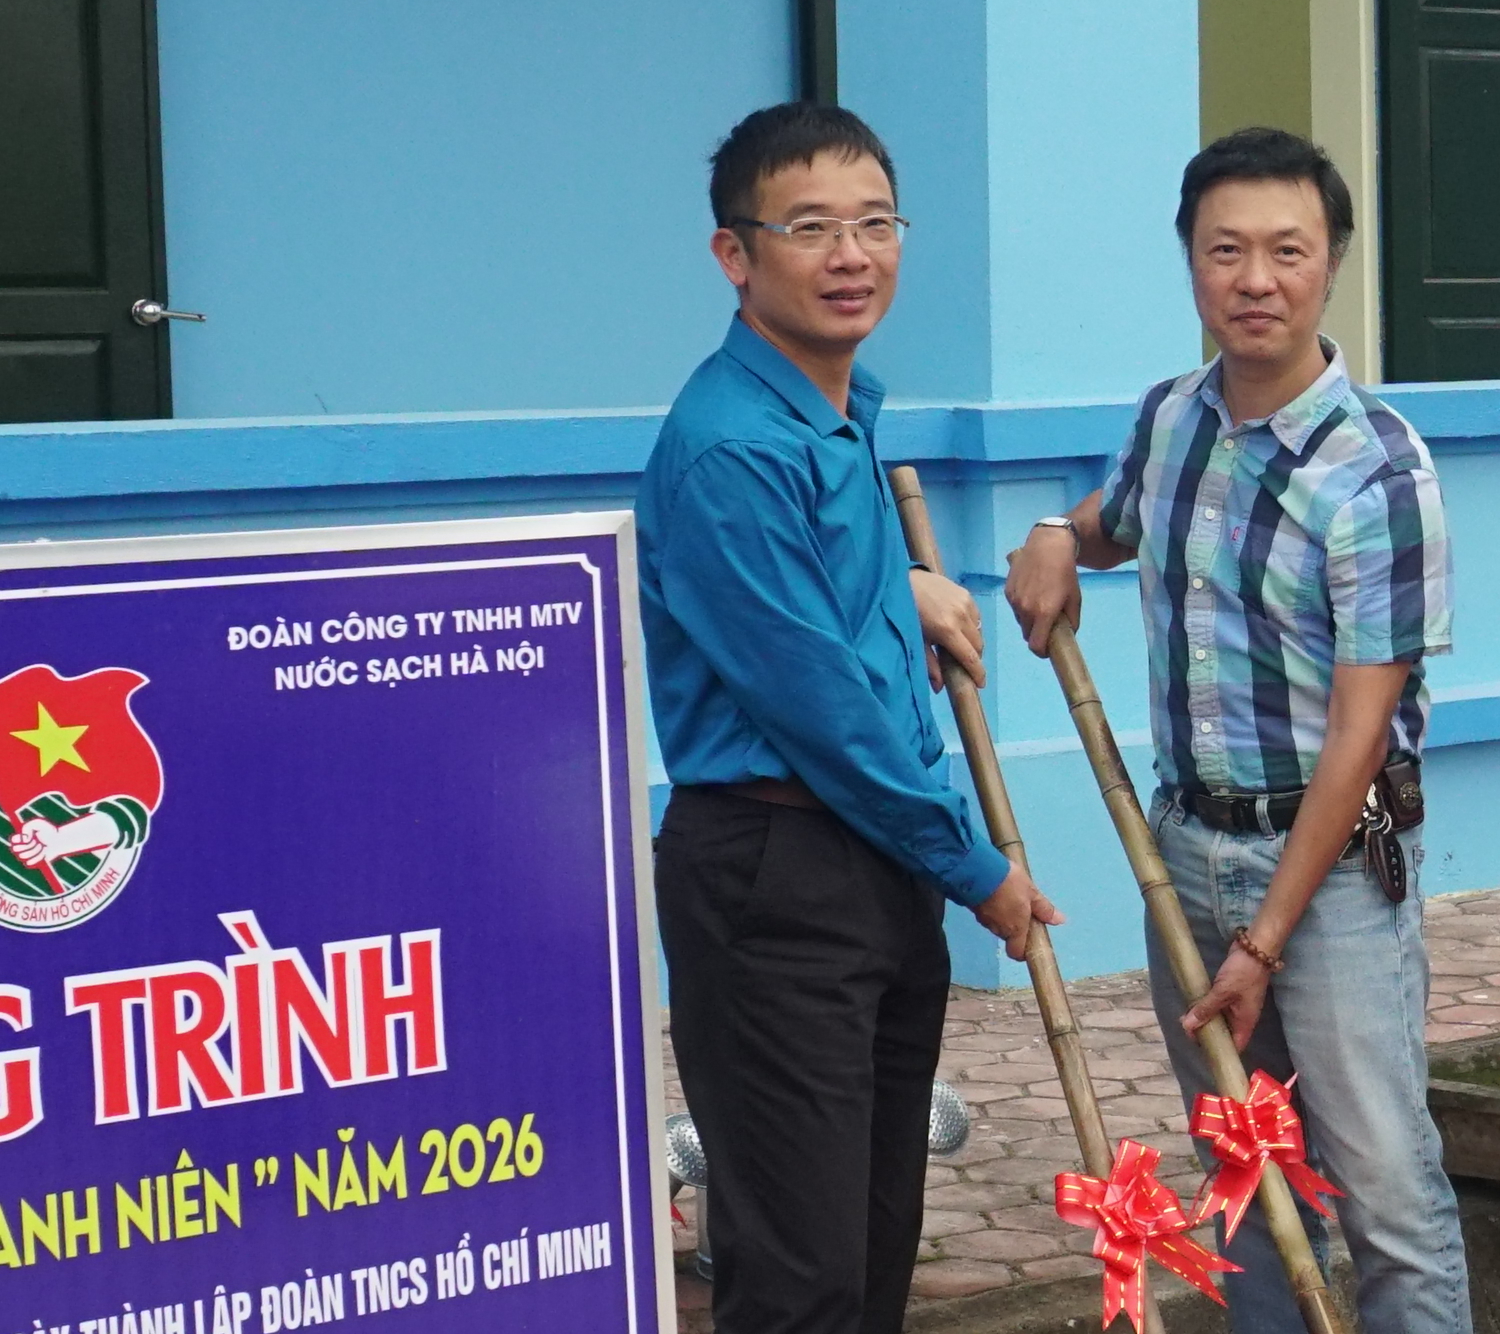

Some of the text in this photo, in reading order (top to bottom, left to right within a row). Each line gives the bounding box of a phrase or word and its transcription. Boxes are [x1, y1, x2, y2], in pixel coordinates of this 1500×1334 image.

[227, 601, 583, 651] ĐOÀN CÔNG TY TNHH MTV
[275, 640, 545, 691] NƯỚC SẠCH HÀ NỘI
[71, 892, 94, 914] CHÍ
[94, 867, 121, 898] MINH
[65, 910, 448, 1126] TRÌNH
[115, 1148, 241, 1249] NIÊN
[295, 1127, 408, 1218] NĂM
[419, 1113, 545, 1195] 2026
[261, 1268, 345, 1334] ĐOÀN
[351, 1260, 429, 1317] TNCS
[436, 1233, 475, 1301] HỒ
[481, 1227, 530, 1291] CHÍ
[536, 1221, 613, 1280] MINH
